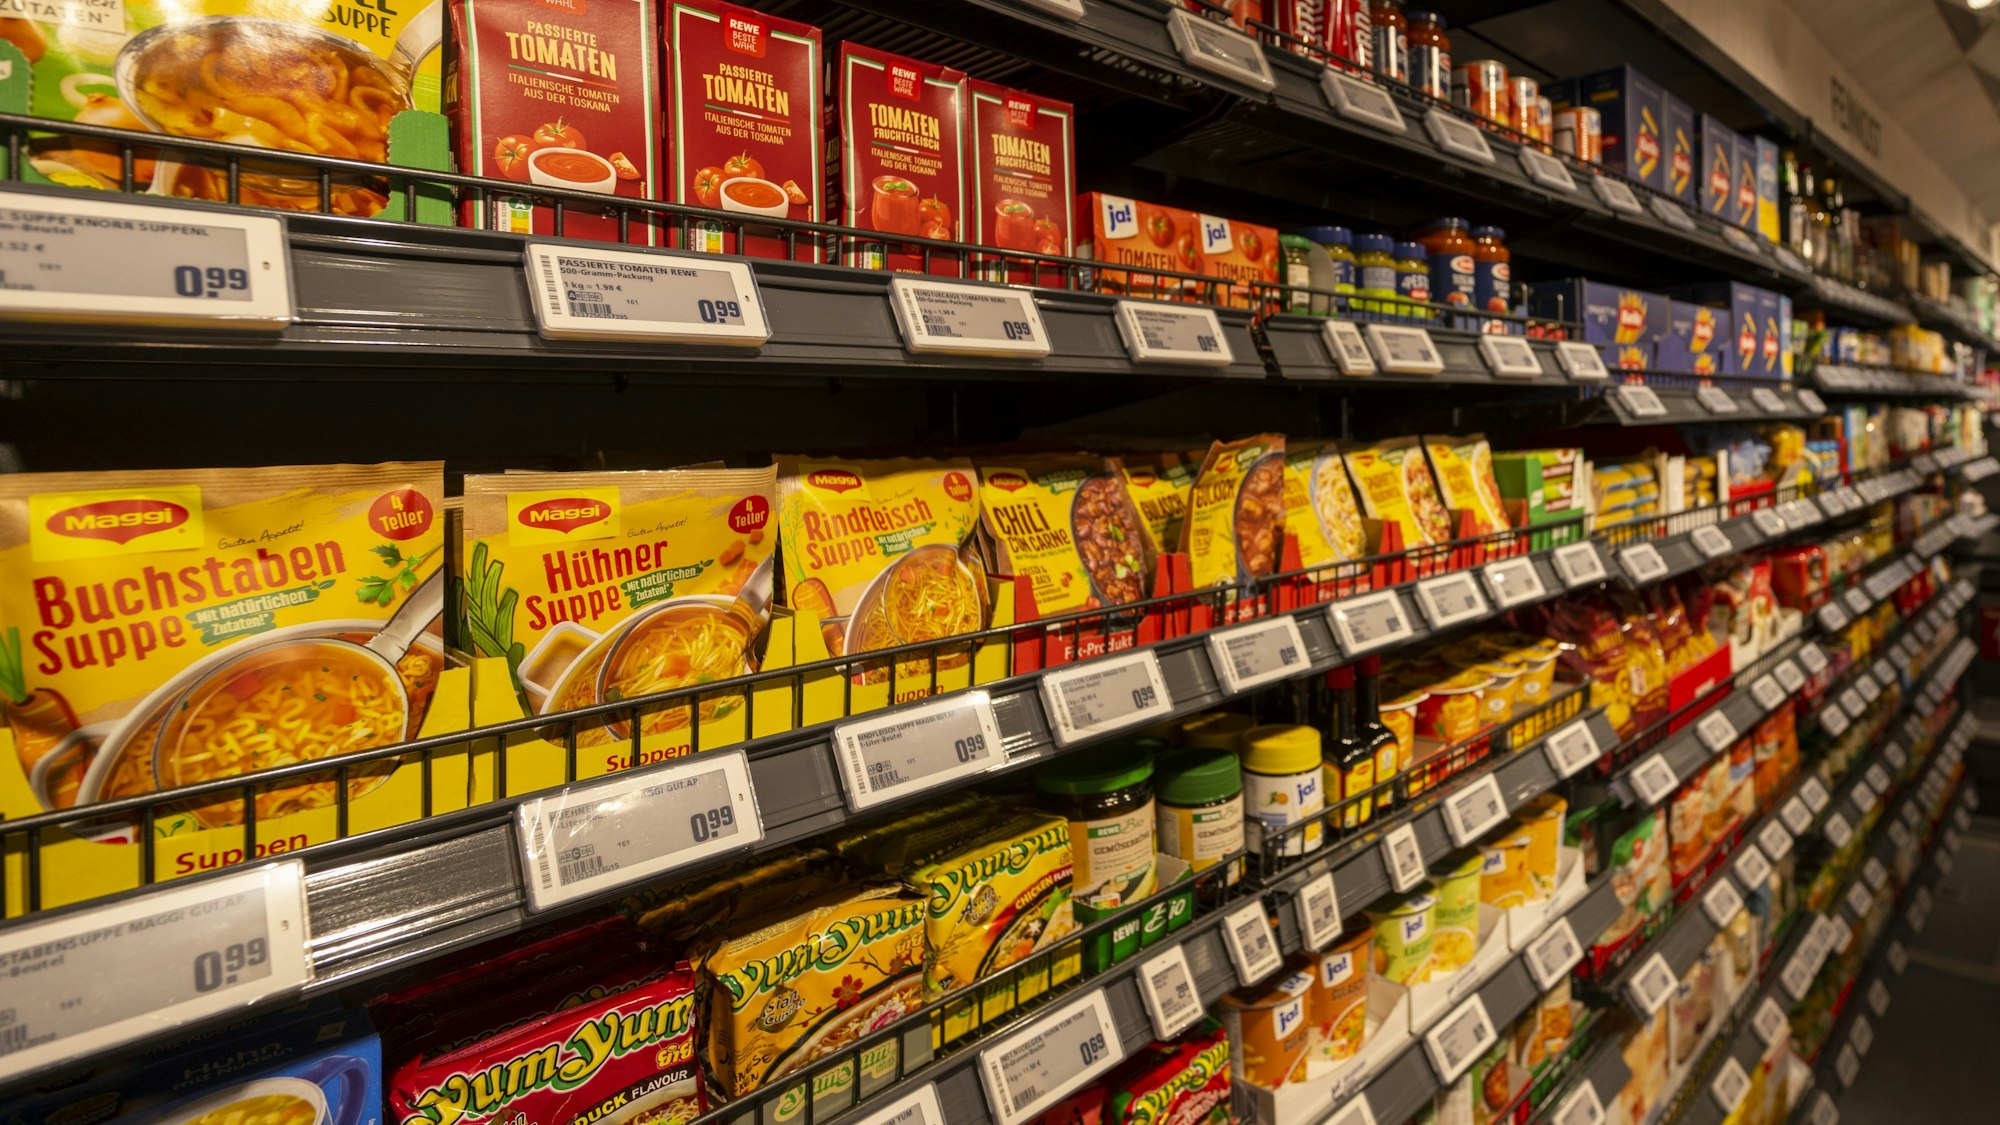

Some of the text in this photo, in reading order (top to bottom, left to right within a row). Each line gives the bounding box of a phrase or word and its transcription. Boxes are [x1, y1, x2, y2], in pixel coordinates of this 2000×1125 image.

[527, 20, 598, 48] PASSIERTE
[730, 18, 760, 35] REWE
[732, 31, 757, 45] BESTE
[505, 31, 617, 81] TOMATEN
[732, 39, 757, 53] WAHL
[719, 63, 774, 86] PASSIERTE
[892, 66, 917, 82] REWE
[893, 77, 914, 90] BESTE
[508, 73, 621, 104] ITALIENISCHE TOMATEN
[523, 88, 612, 113] AUS DER TOSKANA
[702, 73, 790, 117] TOMATEN
[893, 85, 914, 97] WAHL
[1008, 100, 1032, 112] REWE
[704, 112, 792, 137] ITALIENISCHE TOMATEN
[868, 103, 940, 140] TOMATEN
[716, 125, 785, 146] AUS DER TOSKANA
[873, 127, 940, 152] FRUCHTFLEISCH
[871, 147, 943, 169] ITALIENISCHE TOMATEN
[991, 134, 1051, 165] TOMATEN
[880, 159, 937, 176] AUS DER TOSKANA
[995, 156, 1051, 175] FRUCHTFLEISCH
[74, 217, 134, 231] KNORR
[139, 222, 210, 237] SUPPENL
[1107, 204, 1133, 232] ja!
[1206, 223, 1227, 248] ja!
[559, 258, 698, 278] PASSIERTE TOMATEN REWE
[1116, 246, 1177, 272] TOMATEN
[1215, 261, 1265, 282] TOMATEN
[174, 265, 248, 299] 0.99
[560, 266, 654, 283] 500-Gramm-Packung
[563, 281, 569, 289] 1
[571, 281, 584, 291] kg
[595, 283, 615, 292] 1.98
[616, 284, 623, 292] €
[698, 299, 741, 324] 0.99
[1003, 320, 1031, 341] 0.99
[814, 475, 858, 486] Maggi
[948, 483, 970, 496] Teller
[390, 494, 404, 511] 4
[529, 504, 601, 523] Maggi
[745, 499, 754, 512] 4
[64, 507, 174, 537] Maggi
[378, 510, 425, 533] Teller
[734, 509, 766, 528] Teller
[803, 497, 933, 542] Rindfleisch
[217, 536, 257, 550] Guten
[887, 525, 927, 543] natürlichen
[806, 535, 877, 570] Suppe
[542, 540, 669, 595] Hühner
[626, 567, 697, 592] Mit natürlichen
[32, 540, 346, 630] Buchstaben
[195, 589, 308, 624] Mit natürlichen
[525, 583, 623, 631] Suppe
[32, 614, 187, 675] Suppe
[1132, 686, 1155, 709] 0.99
[857, 716, 936, 742] RINDFLEISCH SUPPE MAGGI
[955, 734, 985, 763] 0.99
[1296, 777, 1317, 806] ja!
[690, 805, 733, 843] 0.99
[617, 839, 631, 848] 161
[1015, 876, 1054, 910] CHICKEN
[128, 910, 186, 934] MAGGI
[194, 936, 267, 993] 0.99
[1326, 956, 1347, 982] ja!
[1279, 1003, 1298, 1033] ja!
[1080, 1033, 1105, 1066] 0.69
[631, 1069, 689, 1100] FLAVOUR
[896, 1109, 913, 1123] YUM
